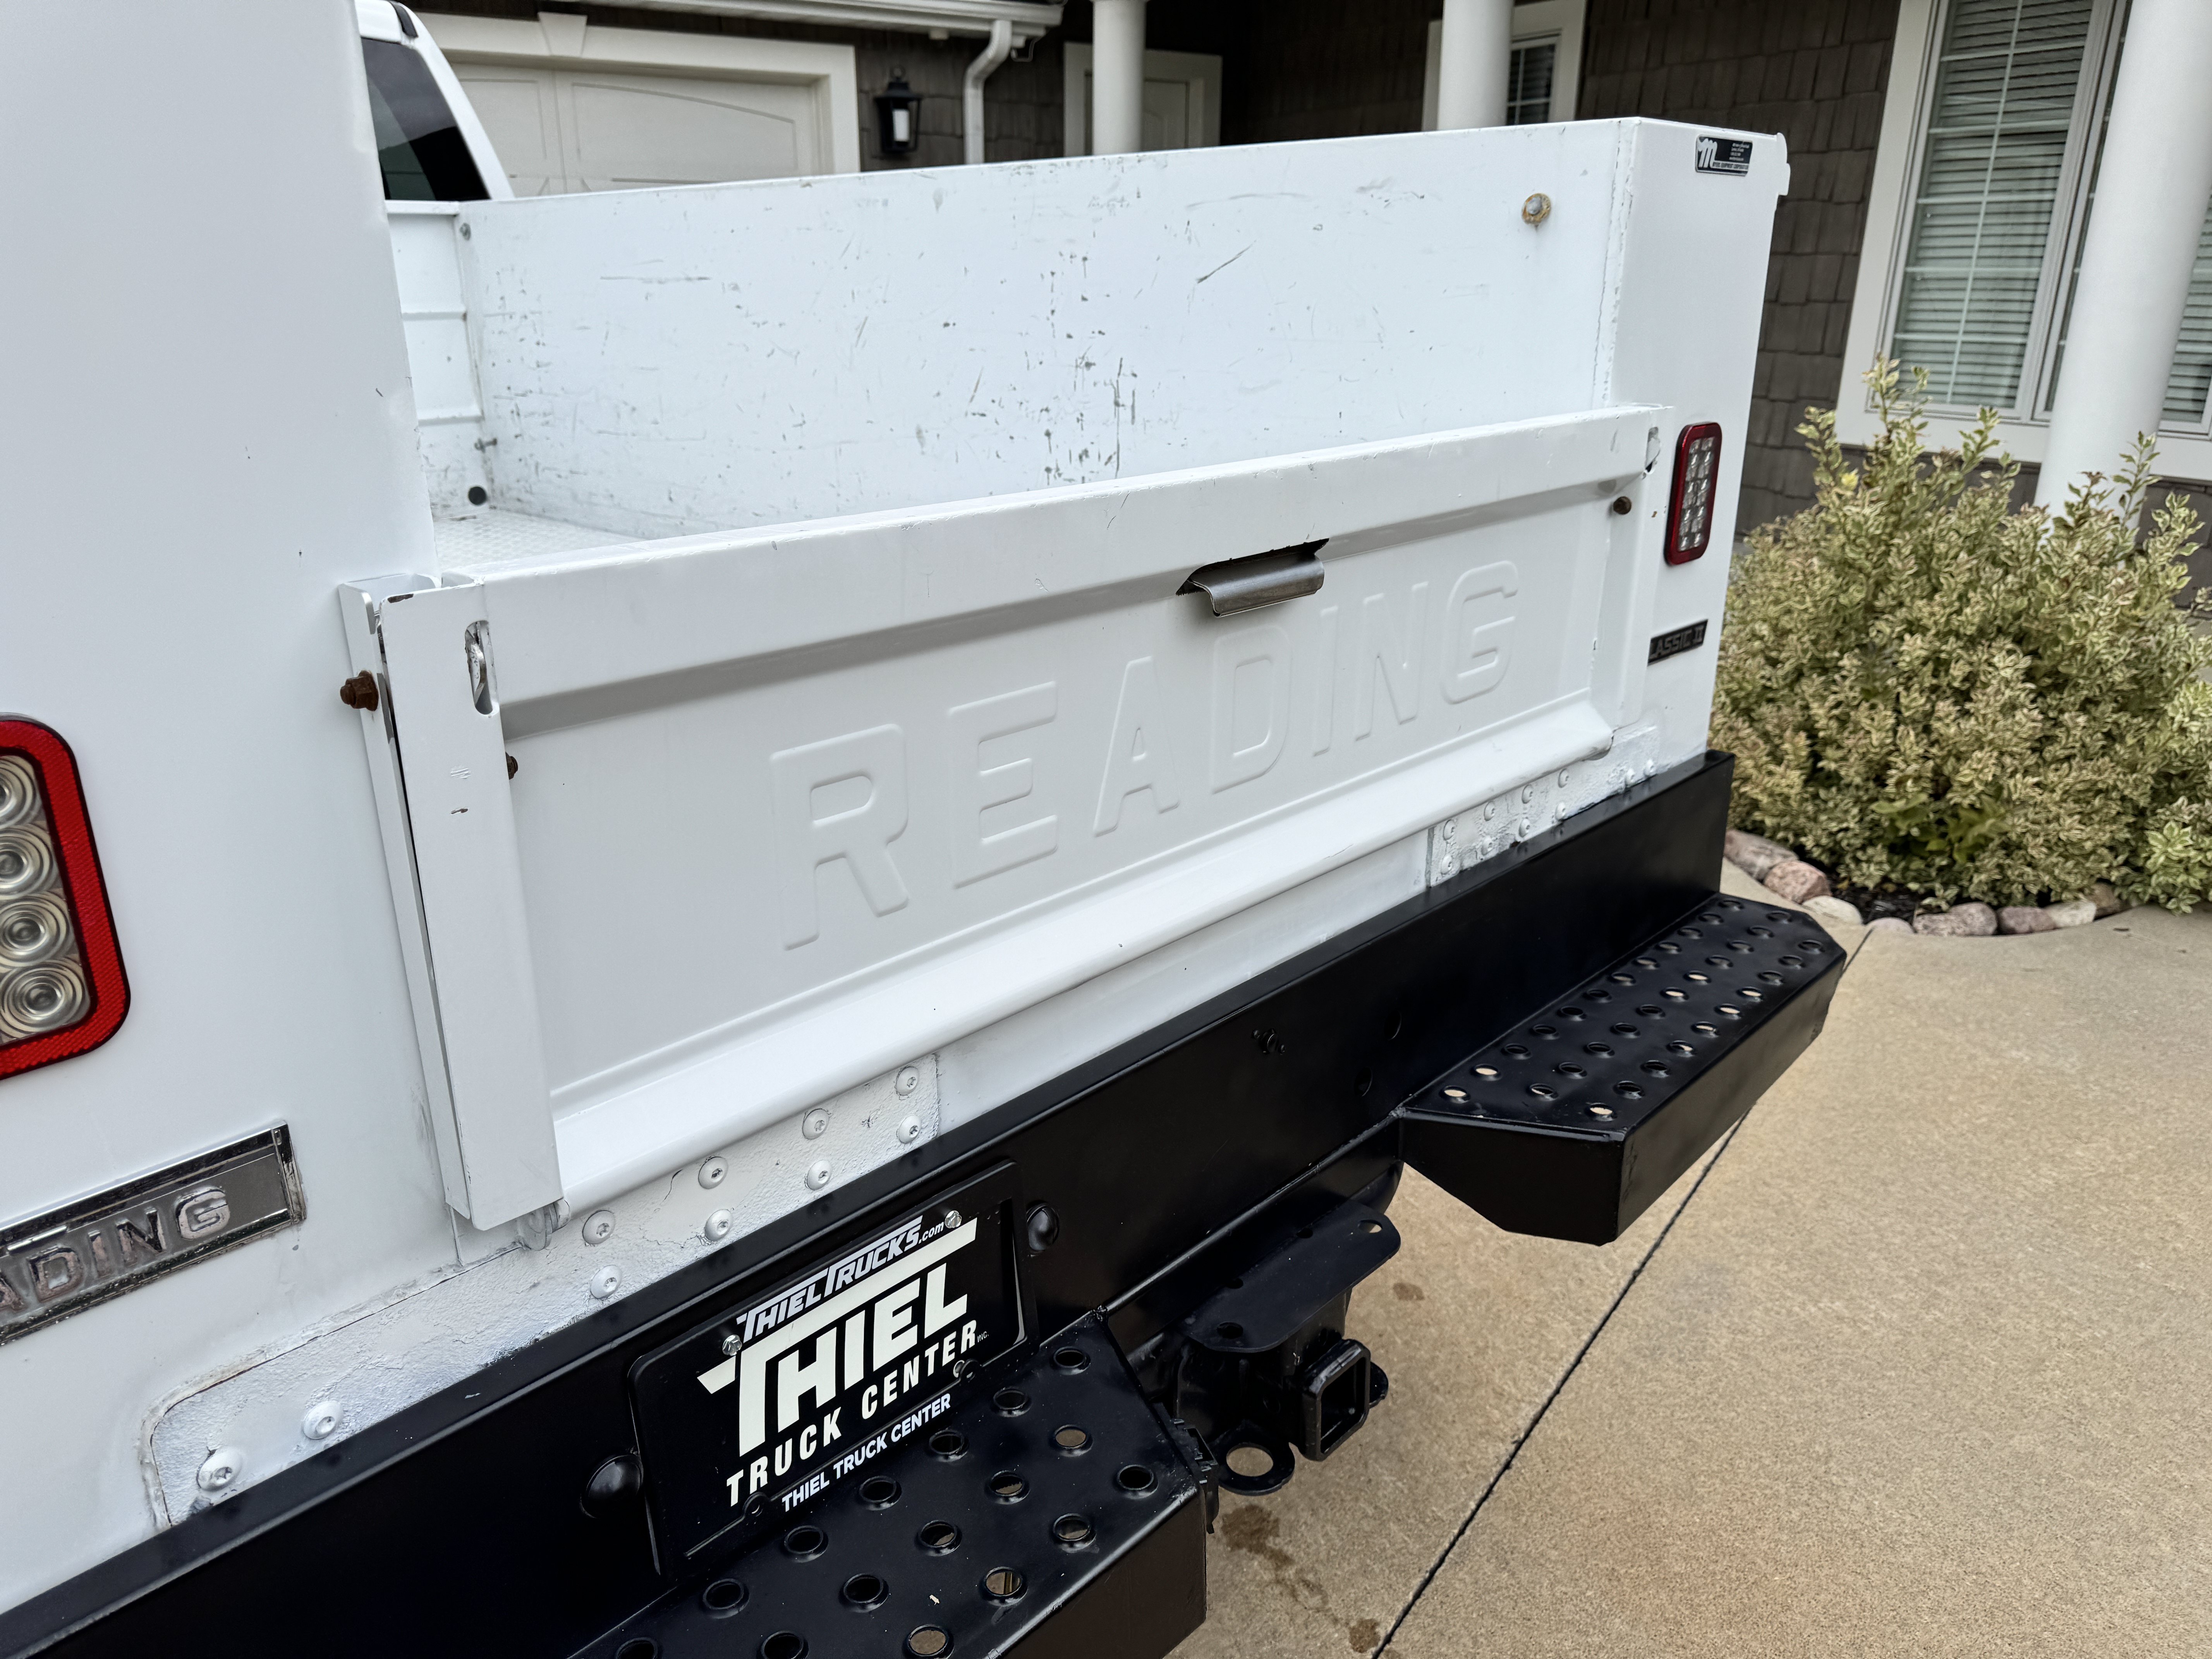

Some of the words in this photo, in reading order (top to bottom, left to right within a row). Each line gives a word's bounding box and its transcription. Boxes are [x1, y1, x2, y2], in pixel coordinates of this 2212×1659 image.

[769, 560, 1519, 951] READING
[697, 1217, 978, 1457] THIEL
[726, 1407, 842, 1507] TRUCK
[861, 1319, 977, 1420] CENTER
[781, 1476, 830, 1513] THIEL
[833, 1436, 887, 1480] TRUCK
[891, 1393, 951, 1442] CENTER
